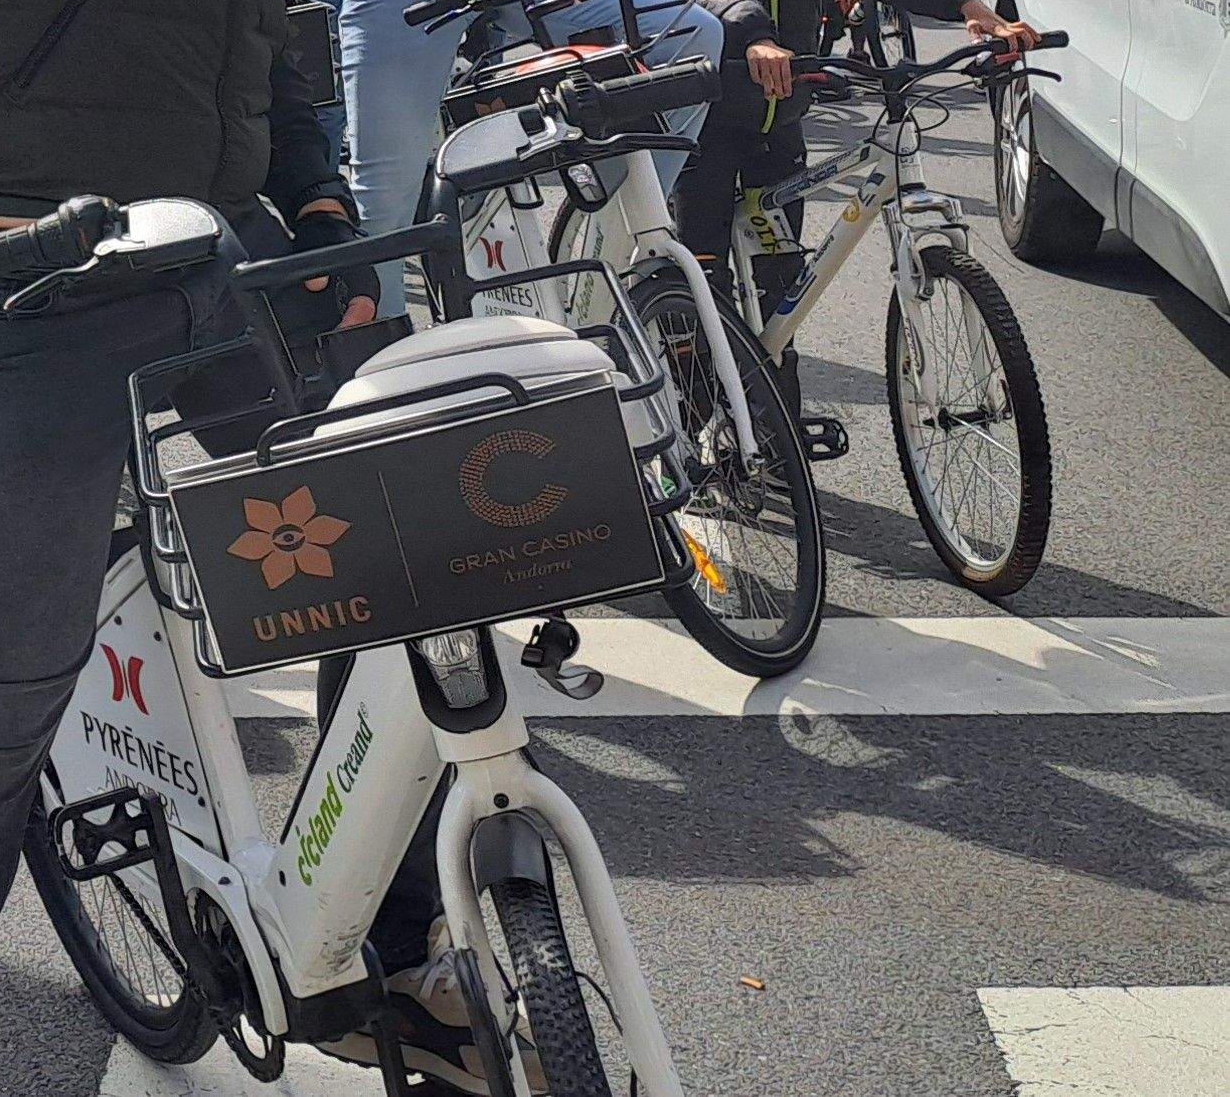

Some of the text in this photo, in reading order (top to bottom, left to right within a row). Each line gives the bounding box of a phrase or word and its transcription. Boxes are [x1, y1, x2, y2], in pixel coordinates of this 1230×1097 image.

[449, 524, 612, 574] GRAN CASINO
[252, 596, 372, 641] UNNIC
